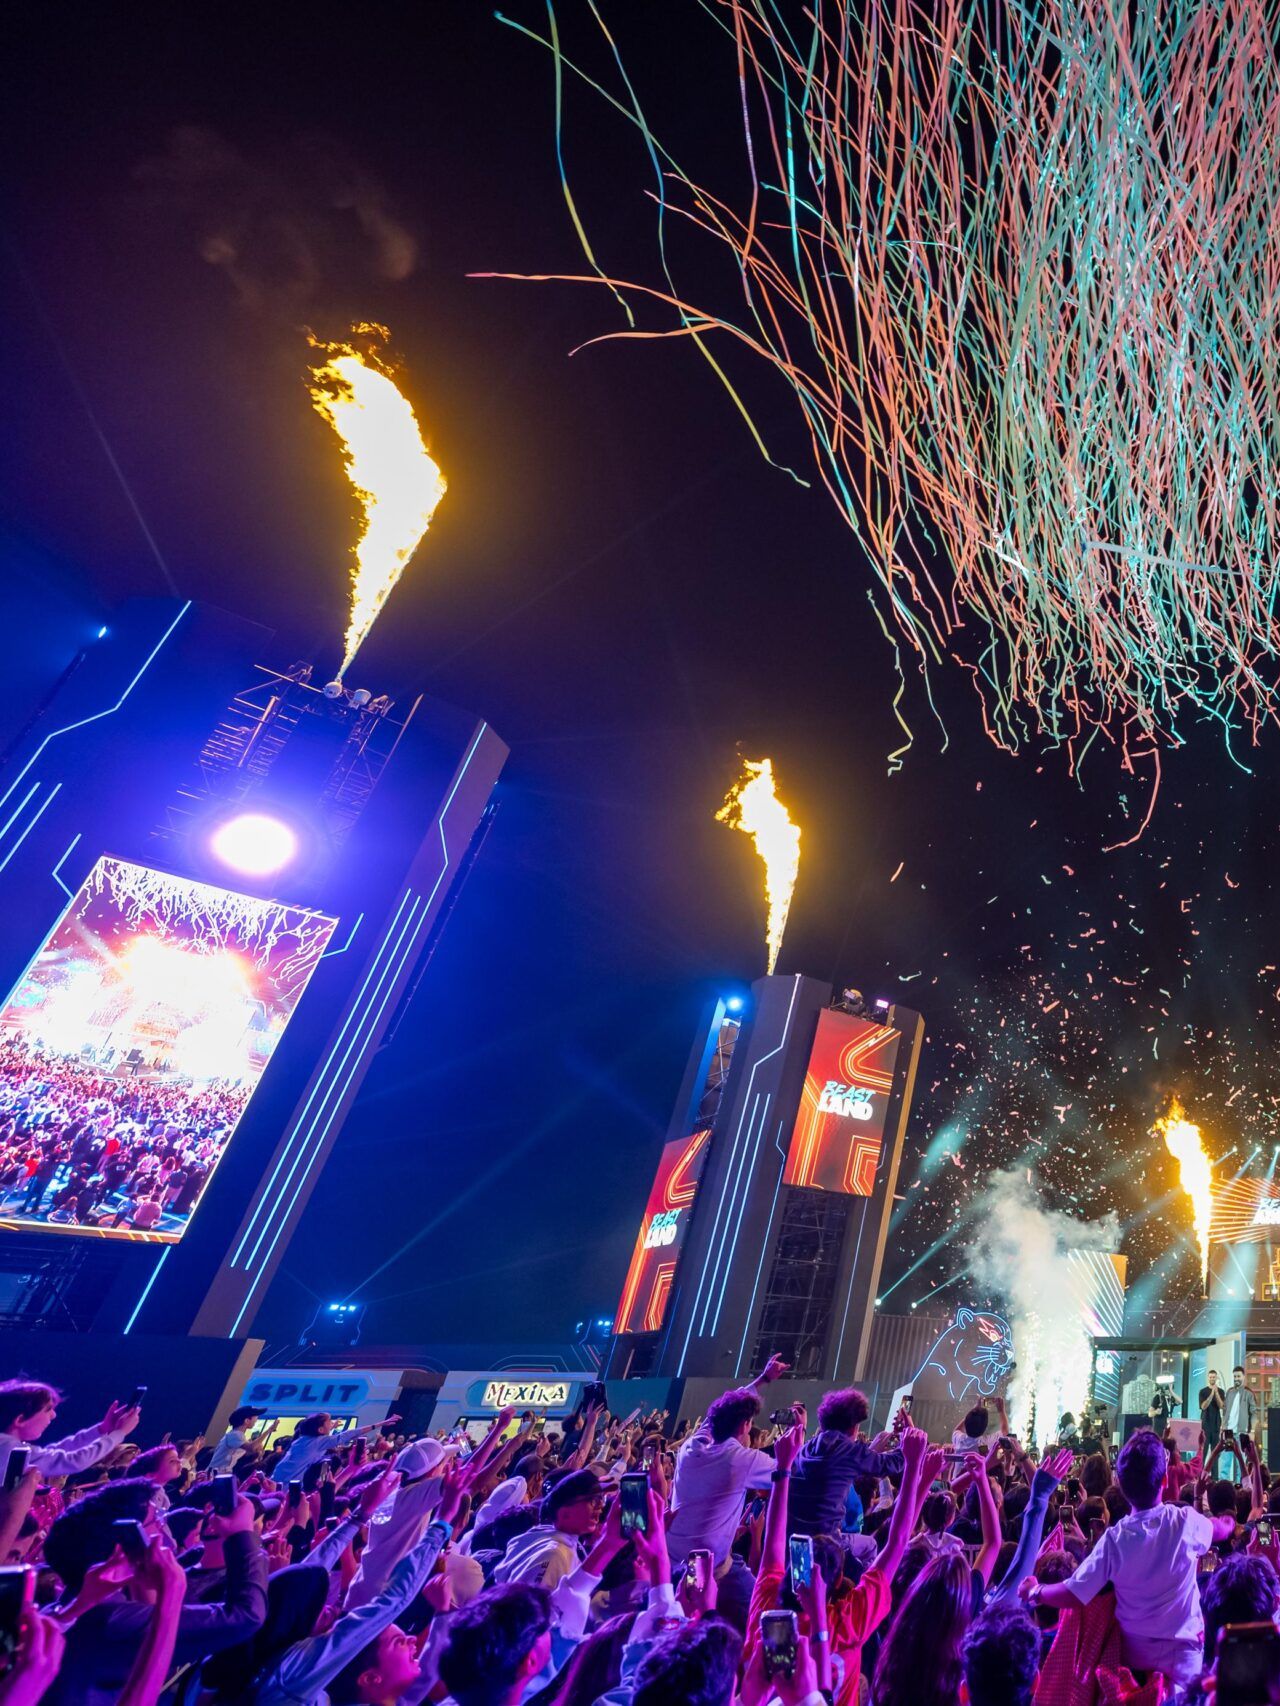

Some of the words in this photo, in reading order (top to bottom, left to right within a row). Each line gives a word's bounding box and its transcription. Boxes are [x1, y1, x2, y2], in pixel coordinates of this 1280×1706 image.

[820, 1081, 876, 1102] BEAST
[817, 1094, 873, 1121] LAND
[650, 1208, 682, 1230] BEAST
[251, 1383, 361, 1402] SPLIT
